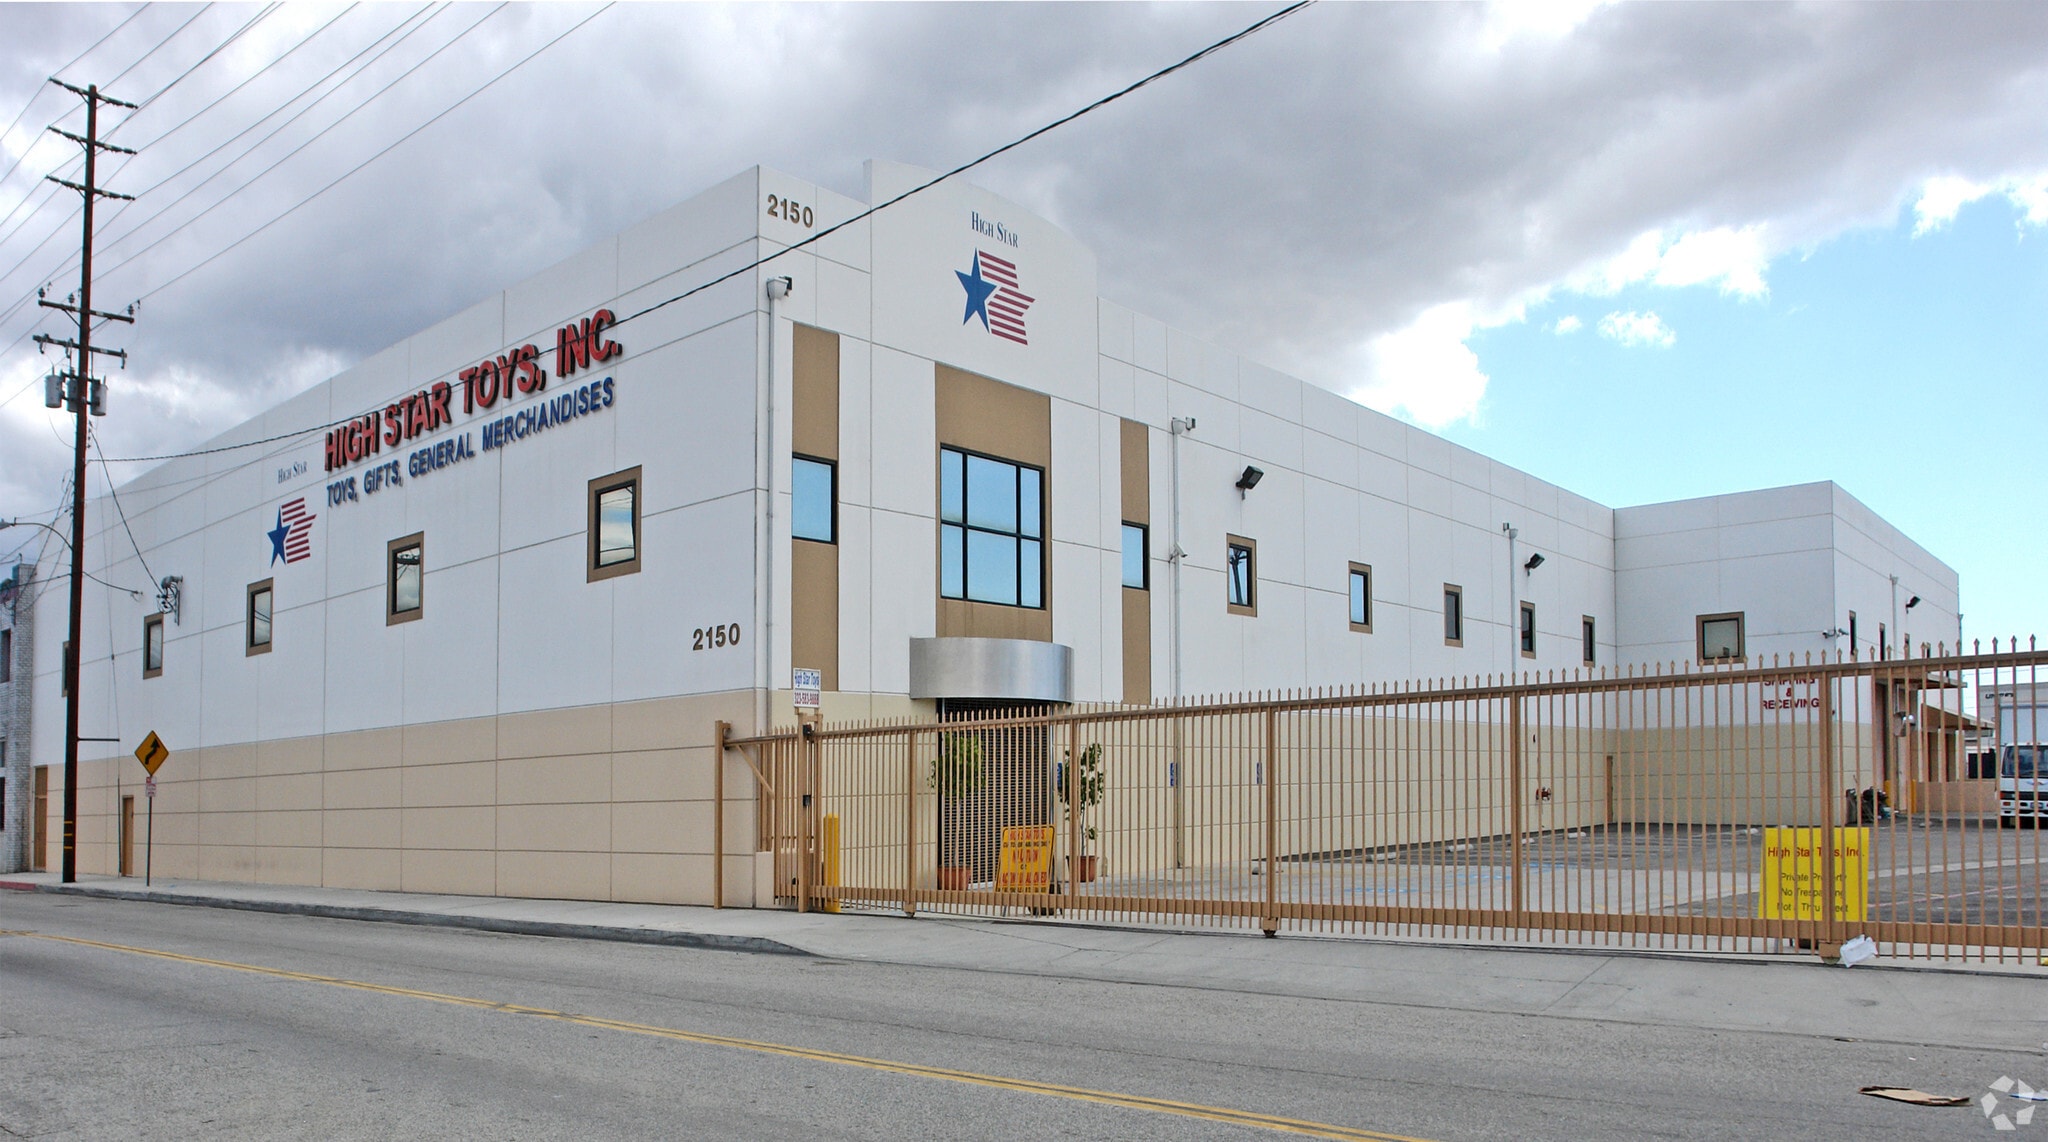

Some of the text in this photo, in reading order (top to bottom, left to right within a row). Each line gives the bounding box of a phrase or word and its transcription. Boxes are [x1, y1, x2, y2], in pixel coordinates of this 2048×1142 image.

[767, 193, 813, 228] 2150
[324, 308, 623, 471] HIGH STAR TOYS, INC.
[326, 376, 615, 507] TOYS, GIFTS, GENERAL MERCHANDISES
[692, 622, 741, 651] 2150
[1767, 846, 1791, 859] High
